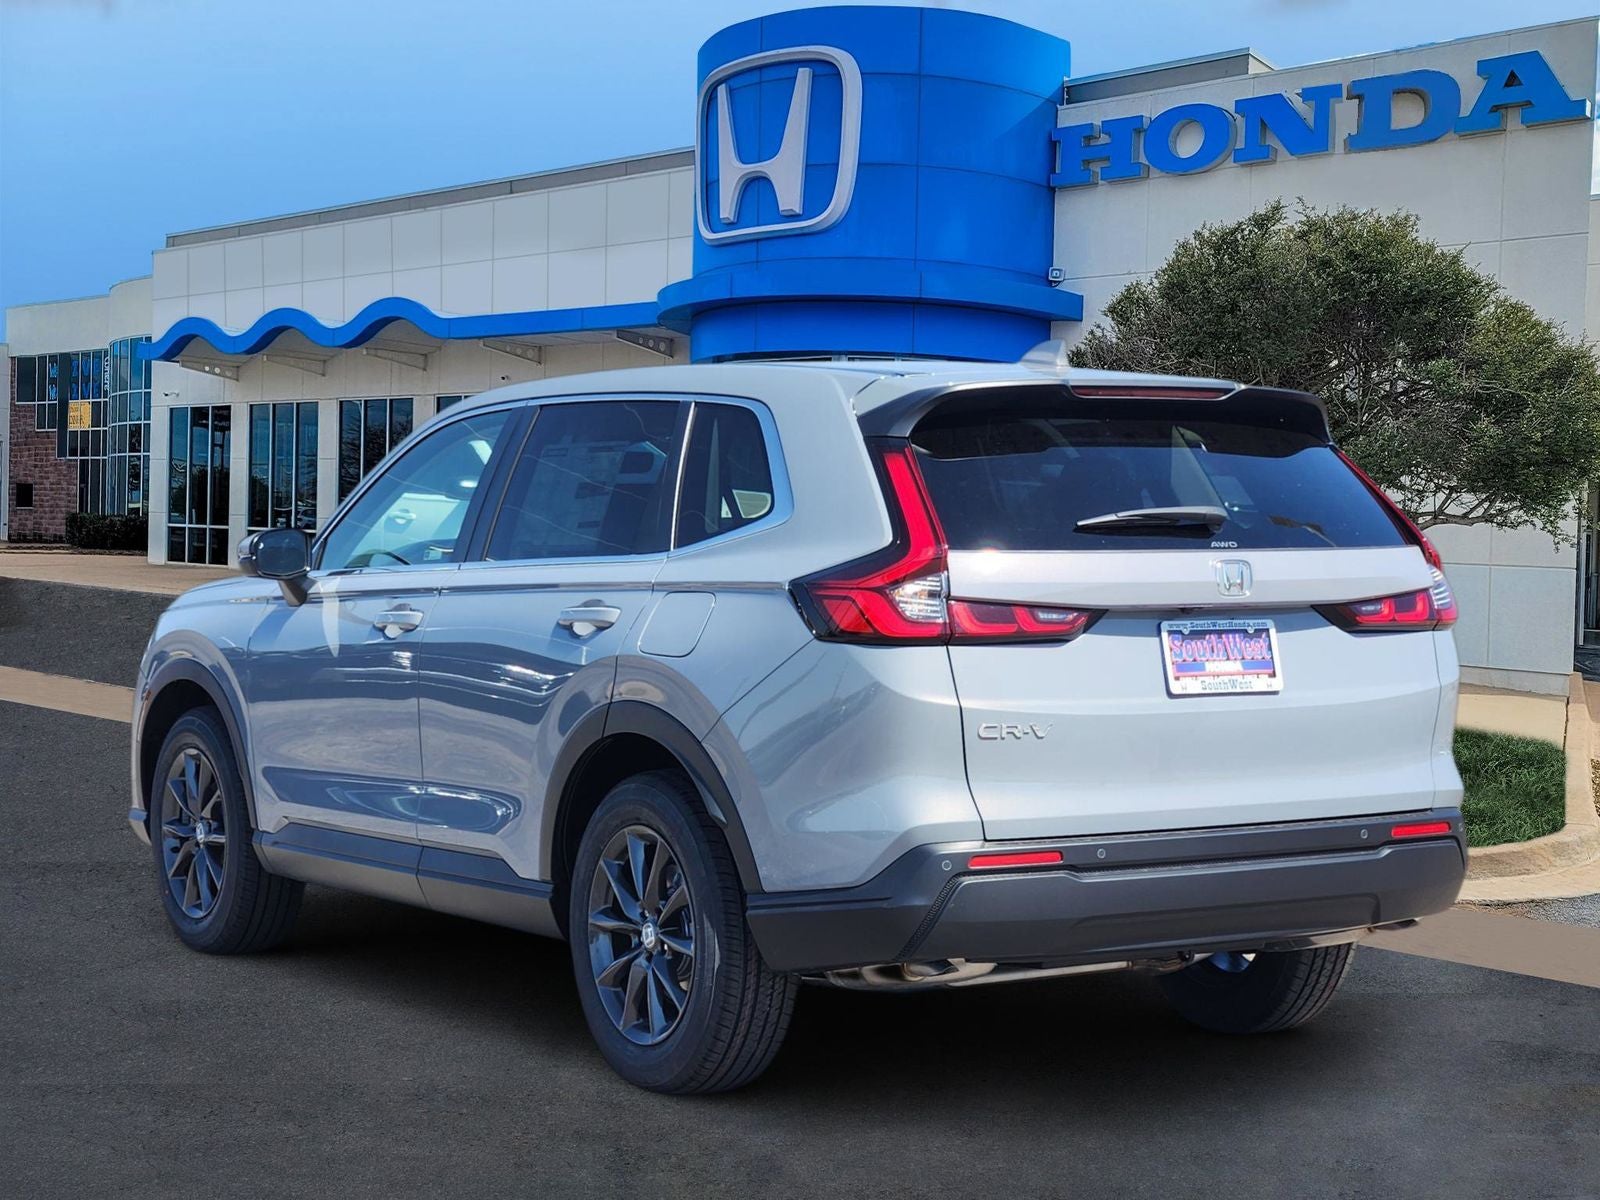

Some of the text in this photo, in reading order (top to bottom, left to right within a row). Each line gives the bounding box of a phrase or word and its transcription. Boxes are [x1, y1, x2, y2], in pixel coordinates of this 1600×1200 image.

[1050, 51, 1591, 188] HONDA
[1168, 632, 1272, 662] SouthWest
[1200, 679, 1254, 691] SouthWest
[978, 722, 1054, 740] CR-V
